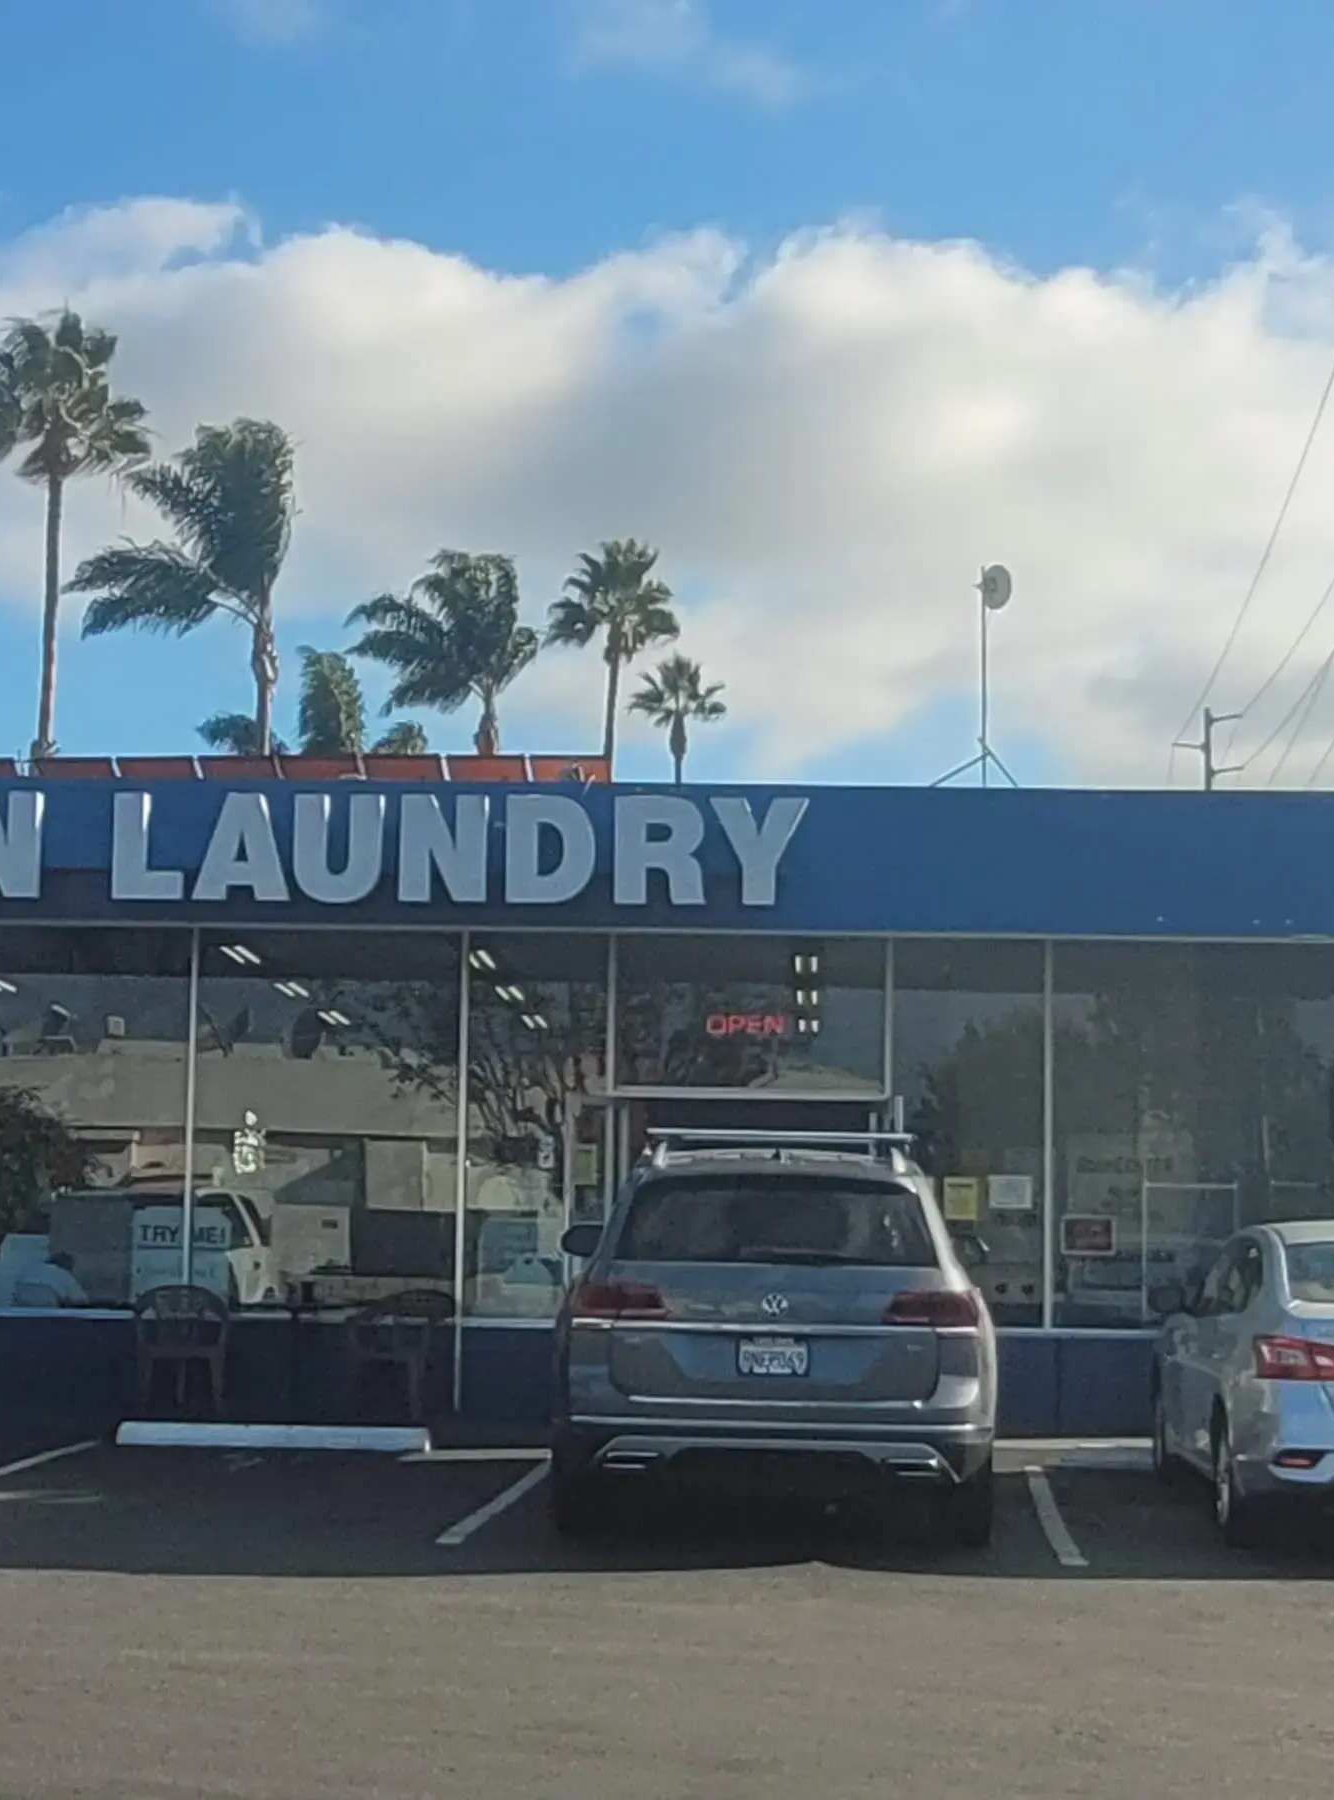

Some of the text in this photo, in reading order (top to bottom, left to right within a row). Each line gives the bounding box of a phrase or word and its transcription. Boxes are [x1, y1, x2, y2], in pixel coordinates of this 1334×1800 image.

[110, 792, 810, 906] LAUNDRY
[706, 1014, 785, 1036] OPEN
[139, 1225, 179, 1243] TRY
